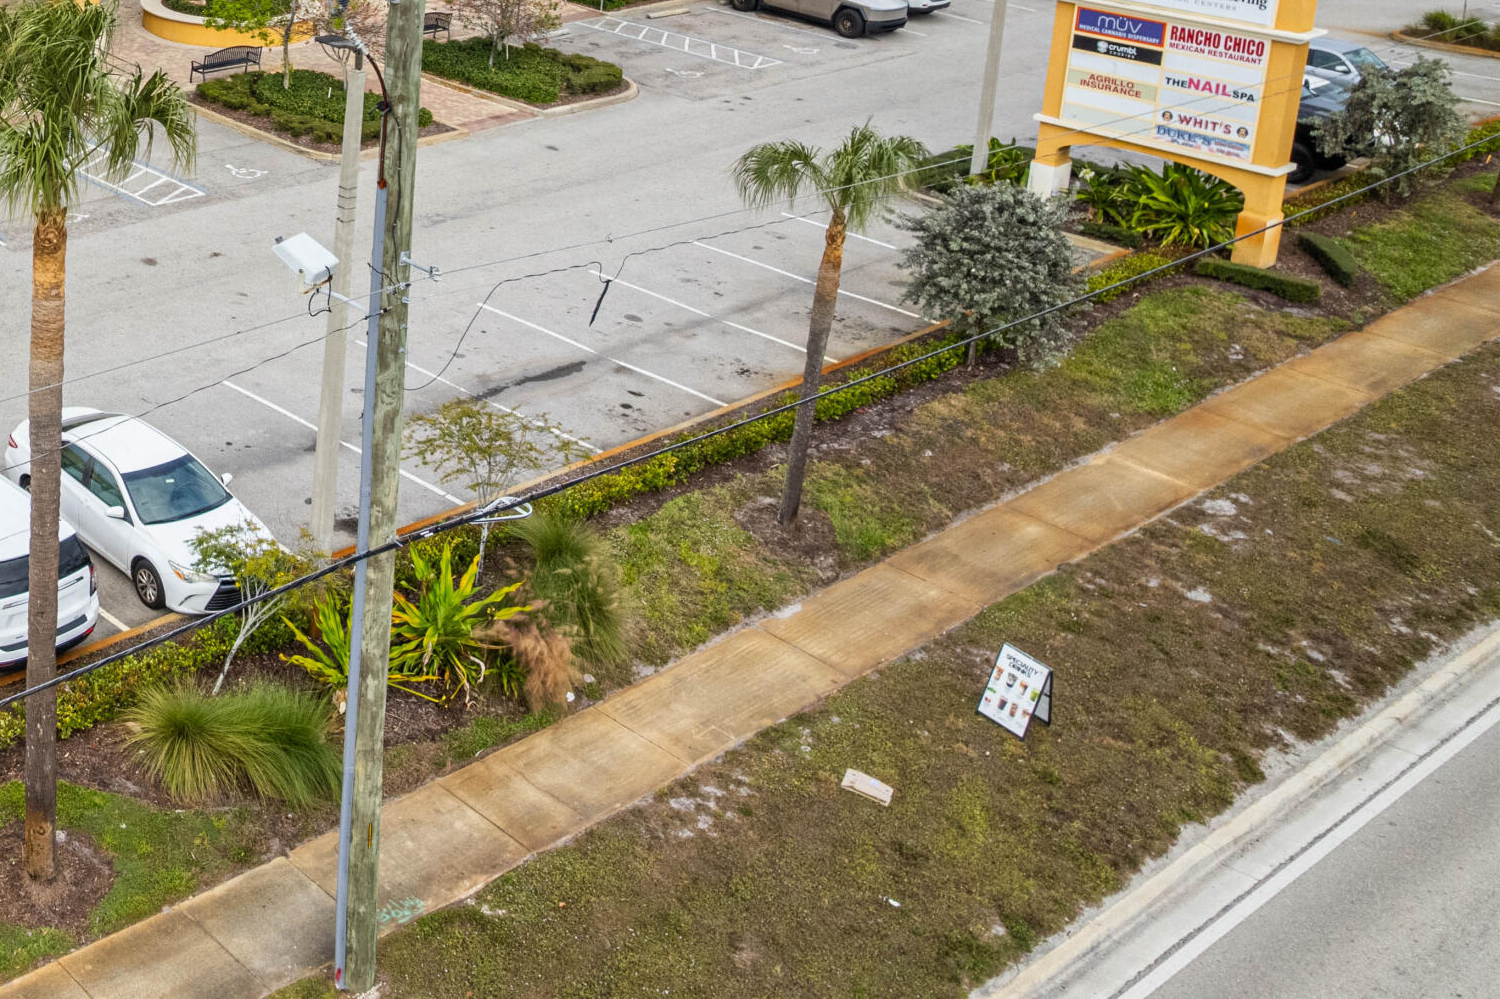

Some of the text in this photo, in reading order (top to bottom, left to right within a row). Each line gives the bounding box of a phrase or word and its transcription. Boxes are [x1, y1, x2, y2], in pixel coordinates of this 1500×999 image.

[1194, 0, 1237, 11] CENTERS
[1079, 24, 1160, 44] MEDICAL CANNABIS DISPENSARY
[1170, 25, 1265, 57] RANCHO CHICO
[1108, 43, 1137, 55] crumbl
[1169, 42, 1262, 65] MEXICAN RESTAURANT
[1080, 79, 1142, 98] INSURANCE
[1088, 73, 1134, 89] AGRILLO
[1165, 76, 1256, 102] THE NAIL SPA
[1178, 114, 1232, 134] WHIT'S
[1156, 124, 1212, 147] DUKE'S
